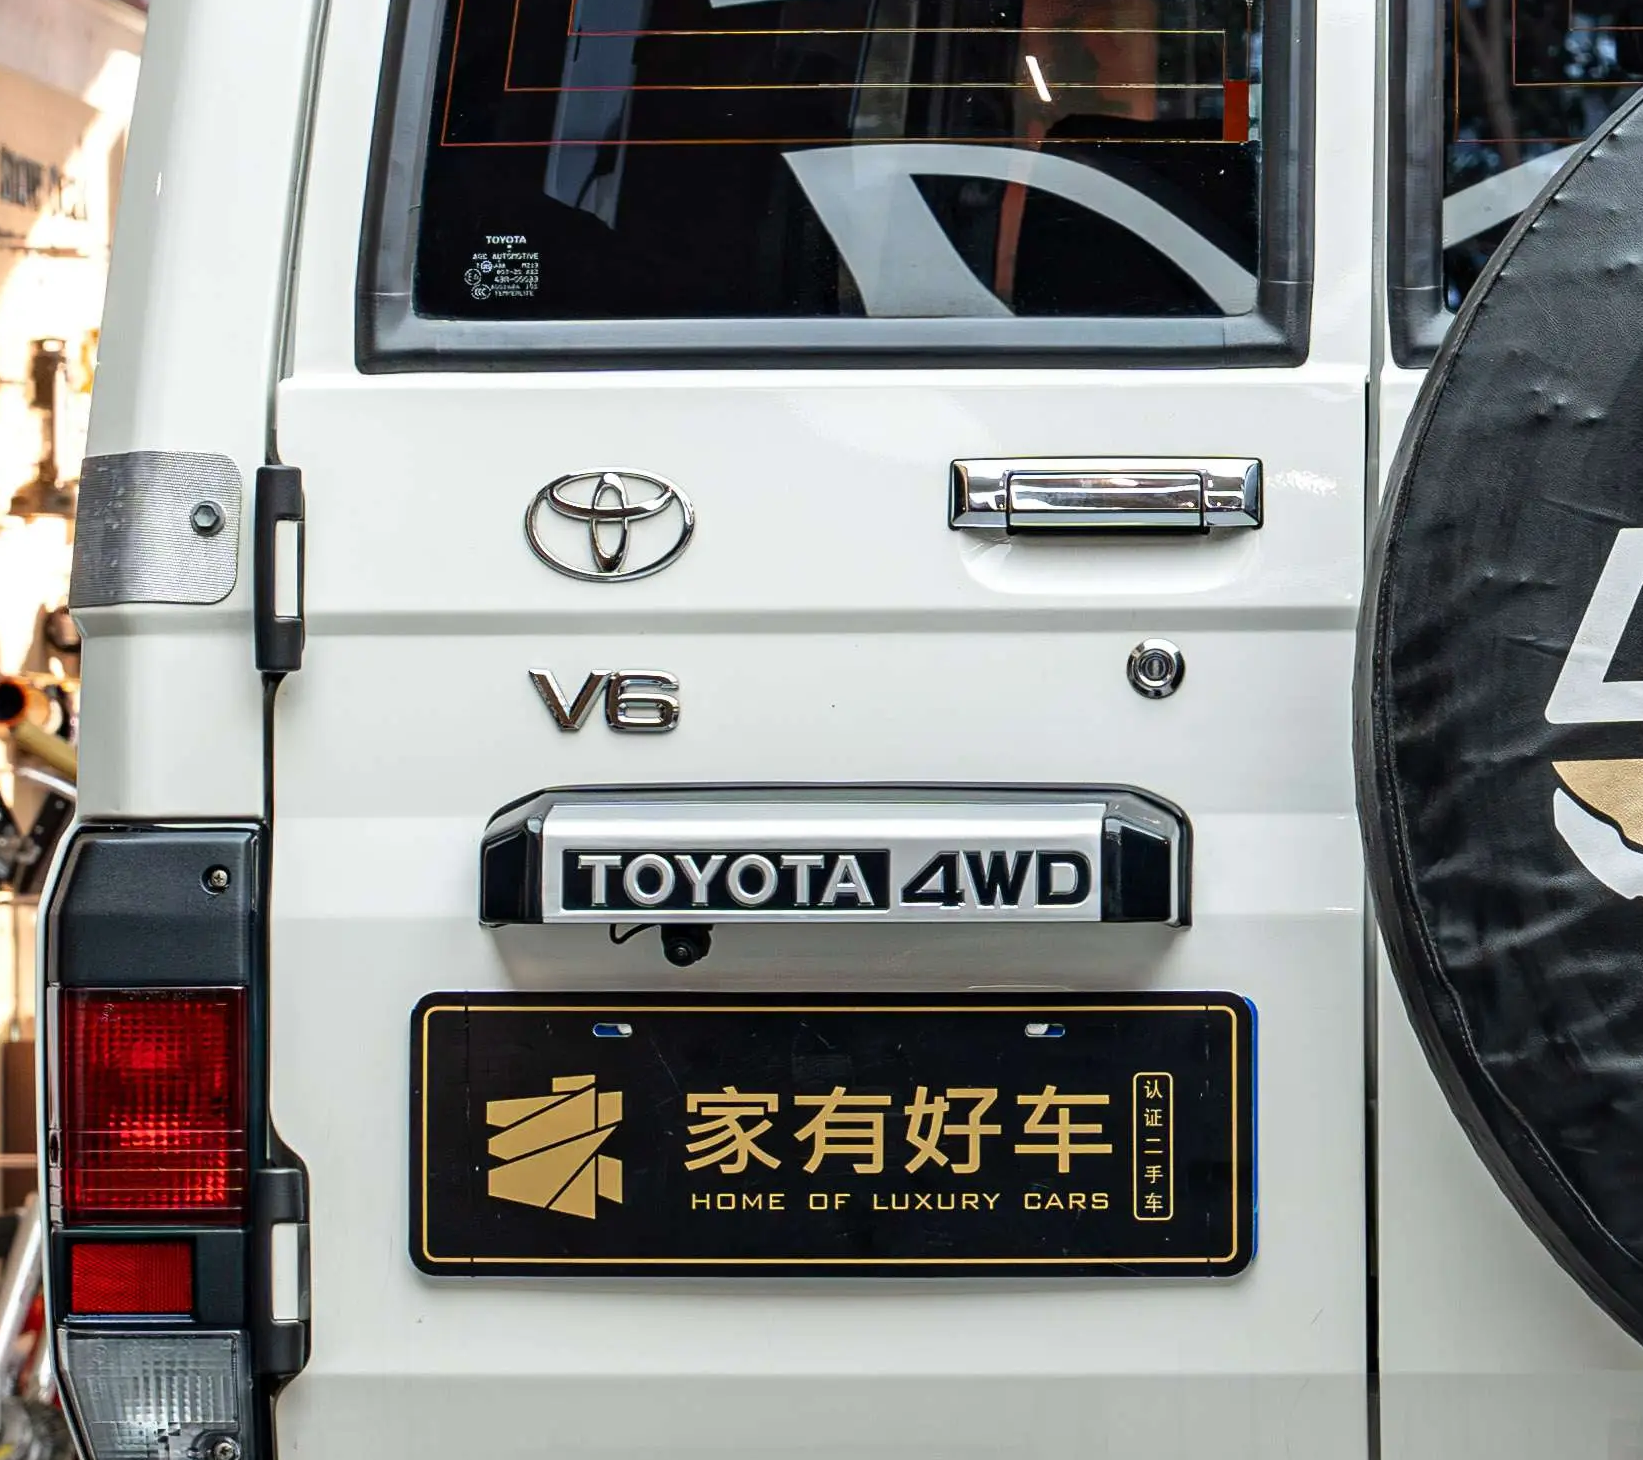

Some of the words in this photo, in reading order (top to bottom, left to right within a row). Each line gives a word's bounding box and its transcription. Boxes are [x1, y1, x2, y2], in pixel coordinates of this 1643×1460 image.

[485, 235, 527, 244] TOYOTA
[528, 668, 680, 734] V6
[578, 853, 875, 907] TOYOTA
[899, 849, 1093, 910] 4WD
[684, 1084, 1113, 1174] 家有好车
[1143, 1079, 1164, 1213] 认证二手车
[691, 1193, 785, 1210] HOME
[809, 1193, 851, 1210] OF
[873, 1193, 1000, 1210] LUXURY
[1024, 1192, 1110, 1210] CARS
